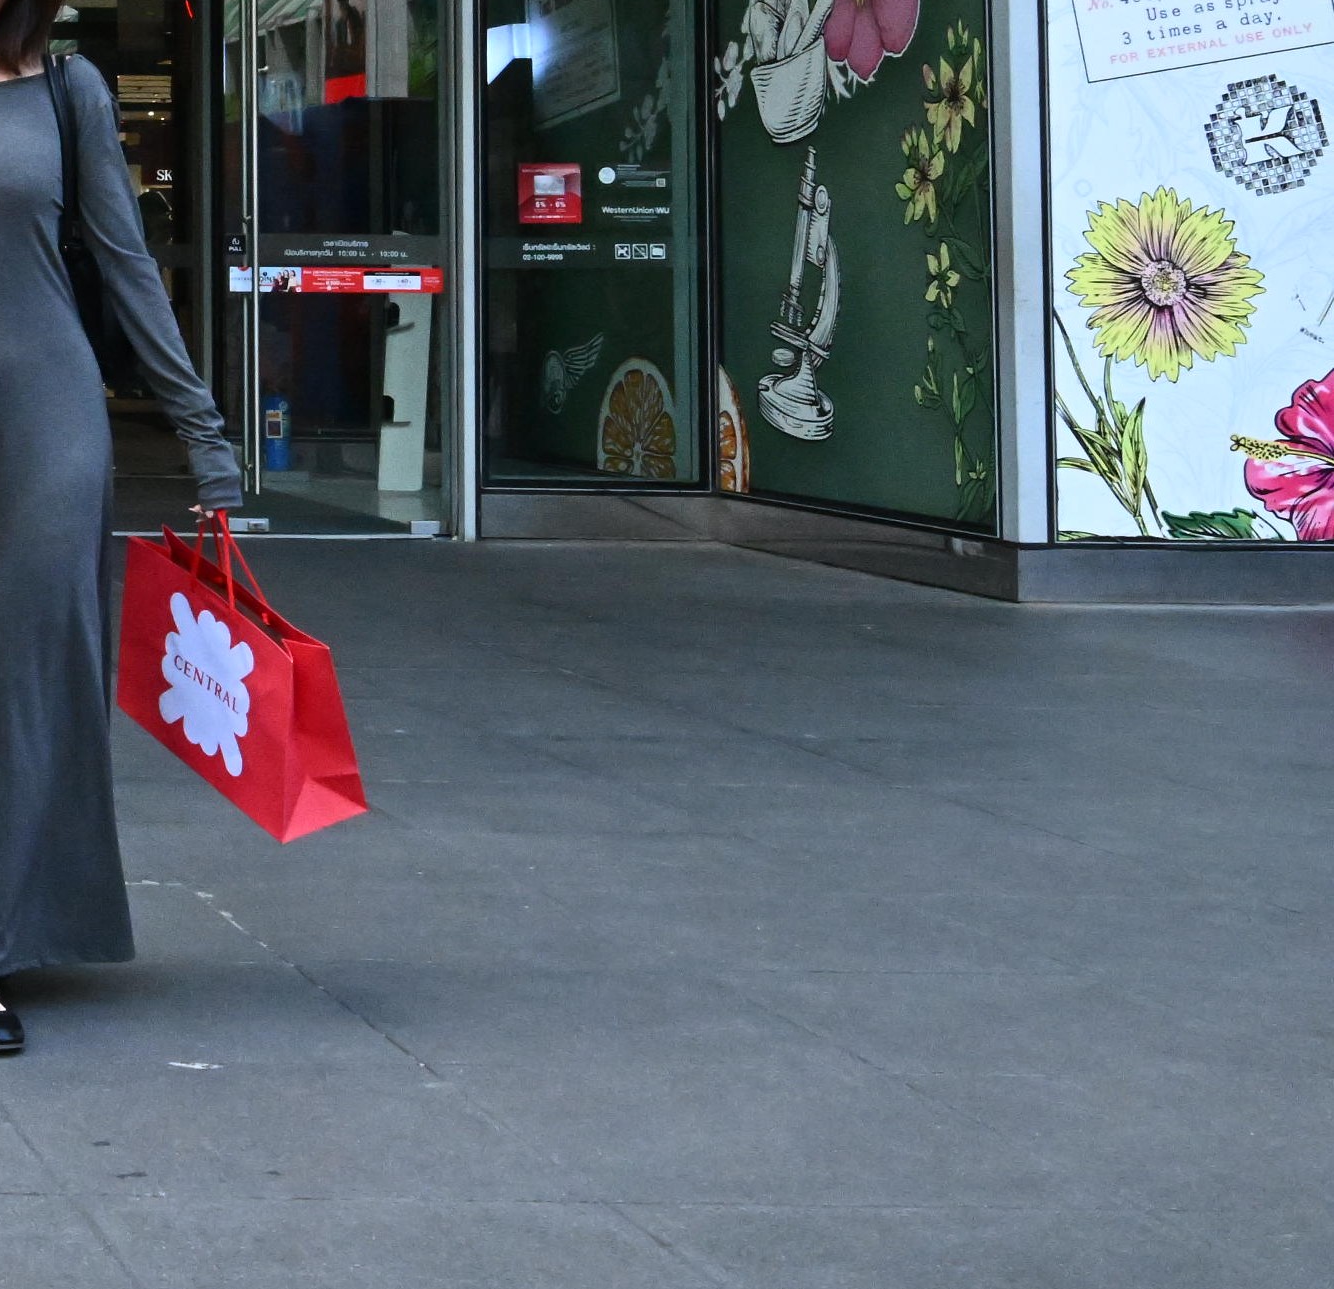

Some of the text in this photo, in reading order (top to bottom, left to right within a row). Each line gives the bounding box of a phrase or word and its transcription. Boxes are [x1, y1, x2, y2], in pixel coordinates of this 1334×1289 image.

[1122, 10, 1282, 45] 3 times a day.
[1146, 6, 1181, 21] Use
[1194, 1, 1215, 14] as
[1109, 22, 1314, 65] FOR EXTERNAL USE ONLY
[173, 654, 239, 714] CENTRAL
